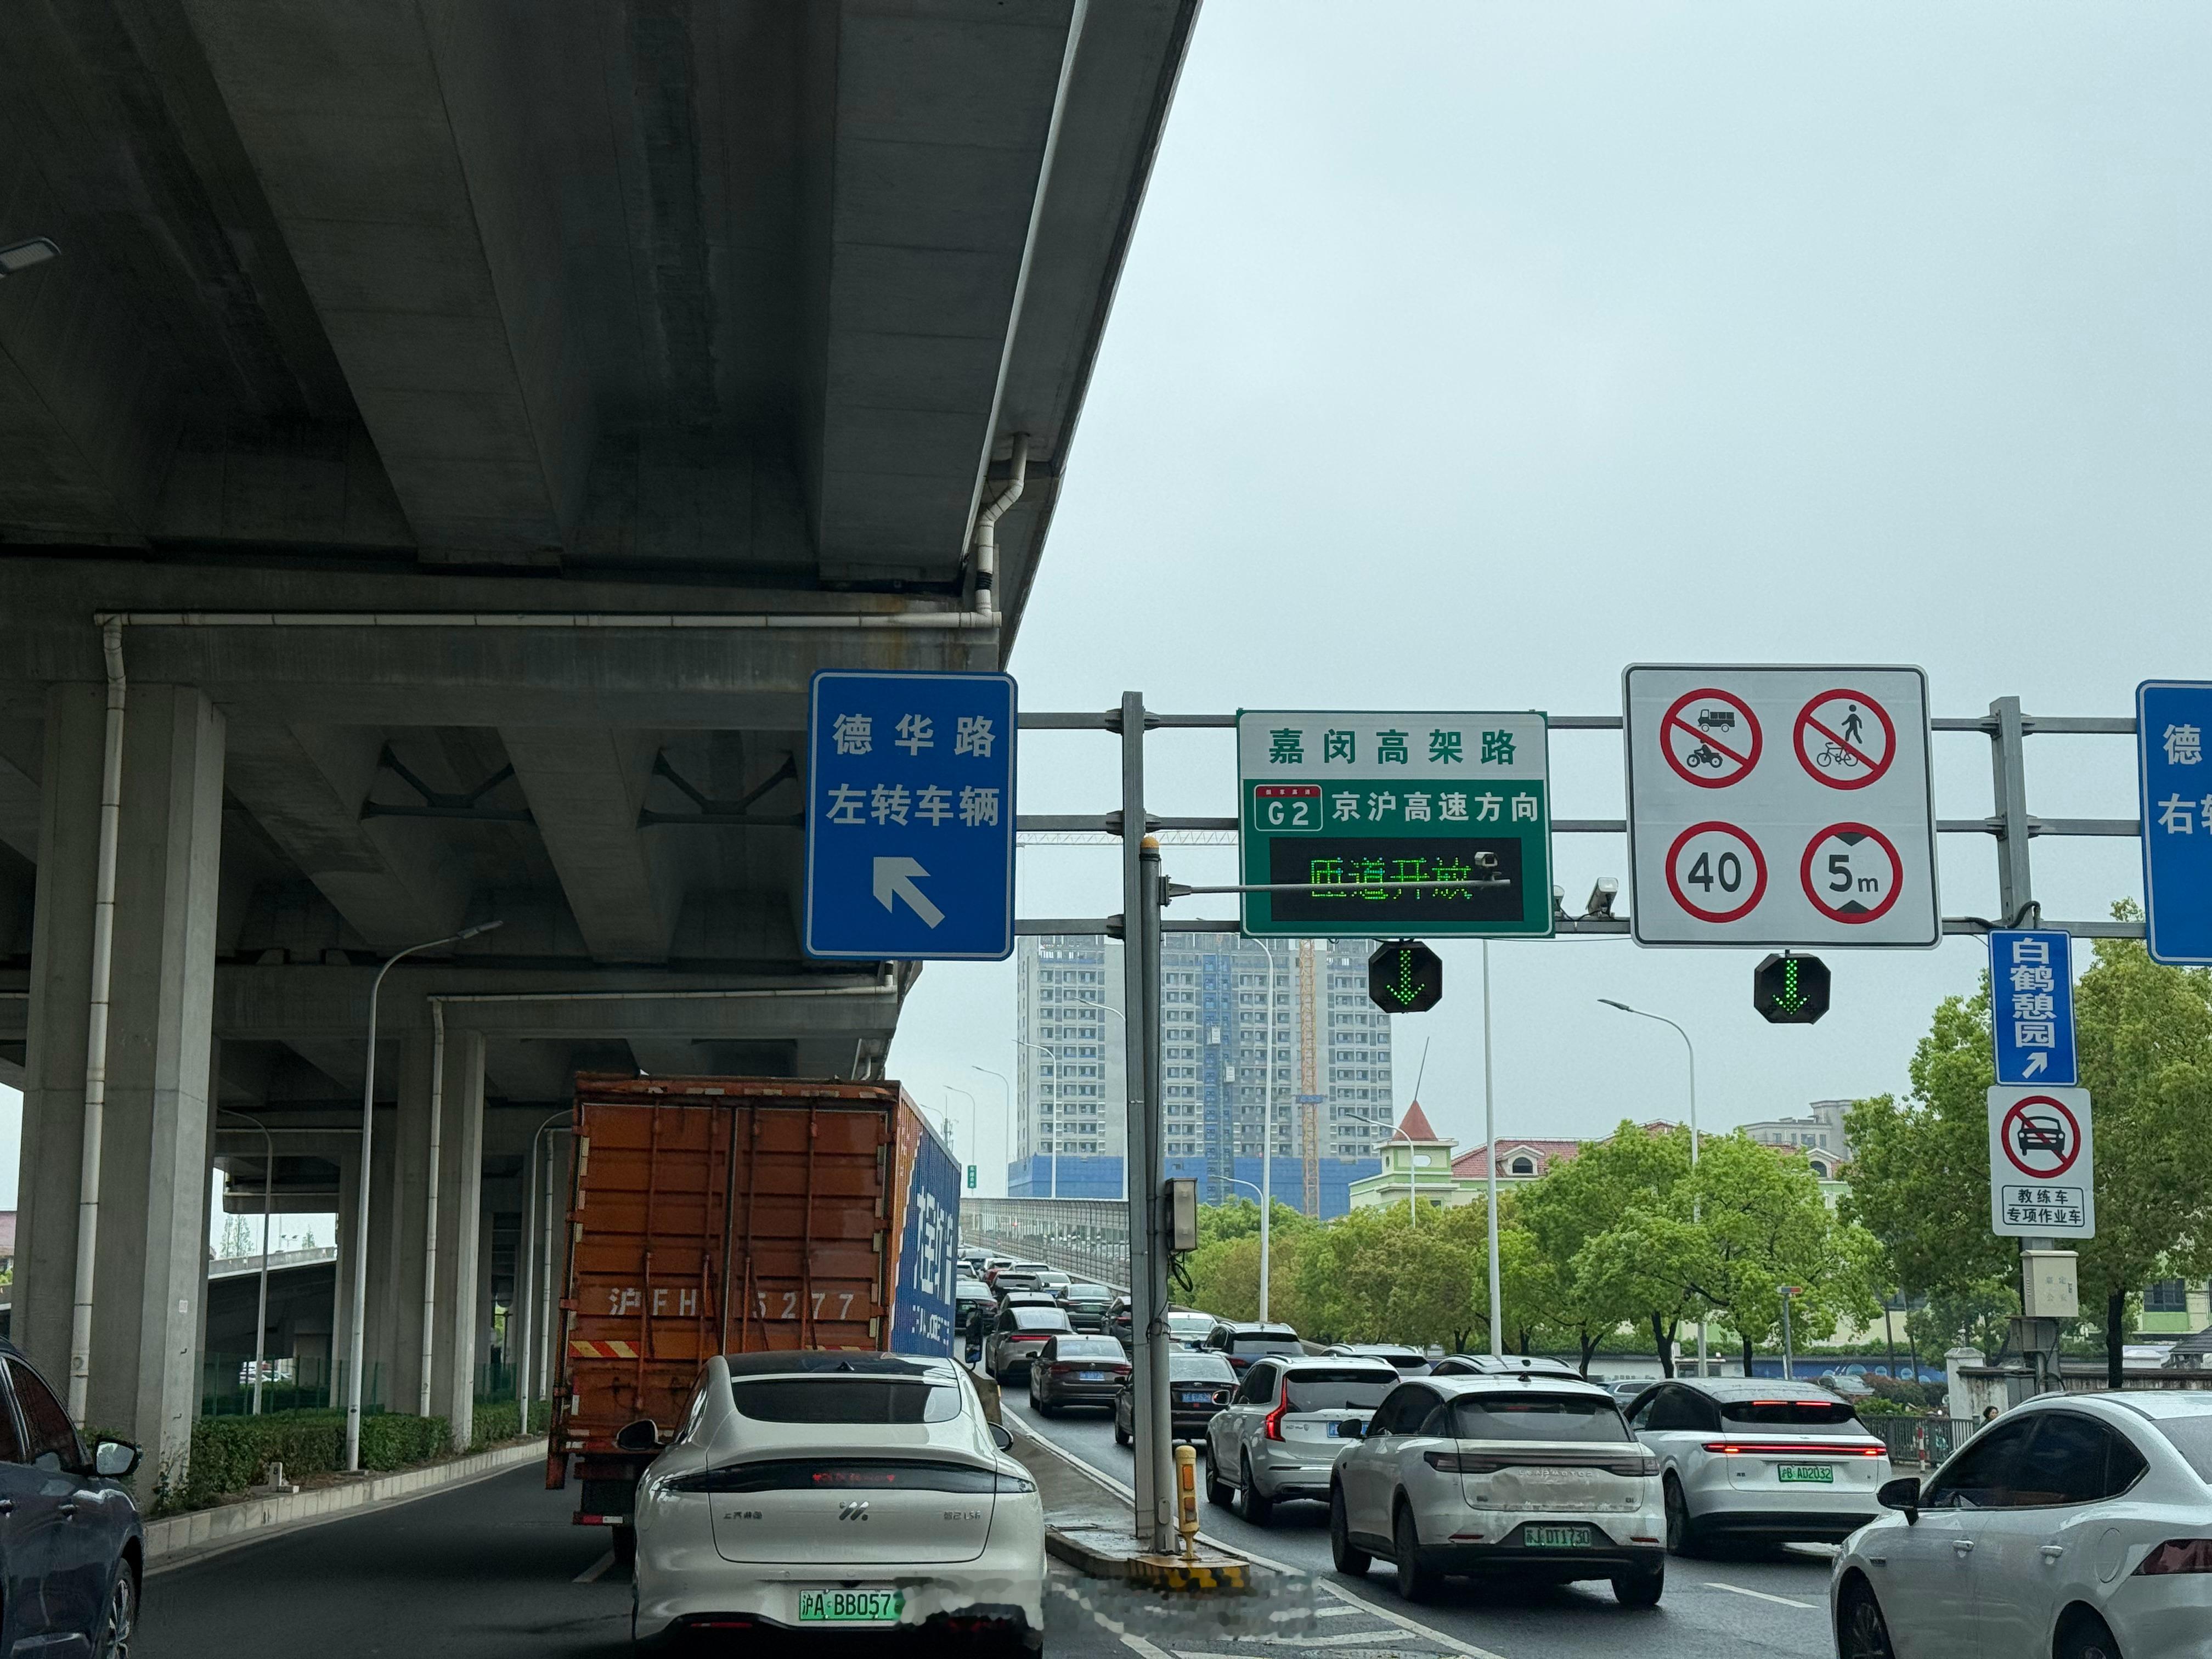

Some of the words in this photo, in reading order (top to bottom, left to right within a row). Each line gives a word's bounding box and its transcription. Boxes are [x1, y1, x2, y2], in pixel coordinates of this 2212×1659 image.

[832, 713, 996, 757] 德华路
[1268, 728, 1517, 765] 嘉闵高架路
[2162, 724, 2203, 765] 德
[826, 783, 1000, 827] 左转车辆
[1268, 801, 1309, 826] G2
[1331, 791, 1538, 822] 京沪高速方向
[2158, 792, 2212, 835] 右
[1311, 856, 1474, 900] 匝道开放
[1688, 851, 1742, 893] 40
[1829, 854, 1879, 893] 5m
[2009, 937, 2057, 1048] 白鹤憩园
[2006, 1207, 2082, 1224] 专项作业车
[2018, 1188, 2068, 1205] 教练车
